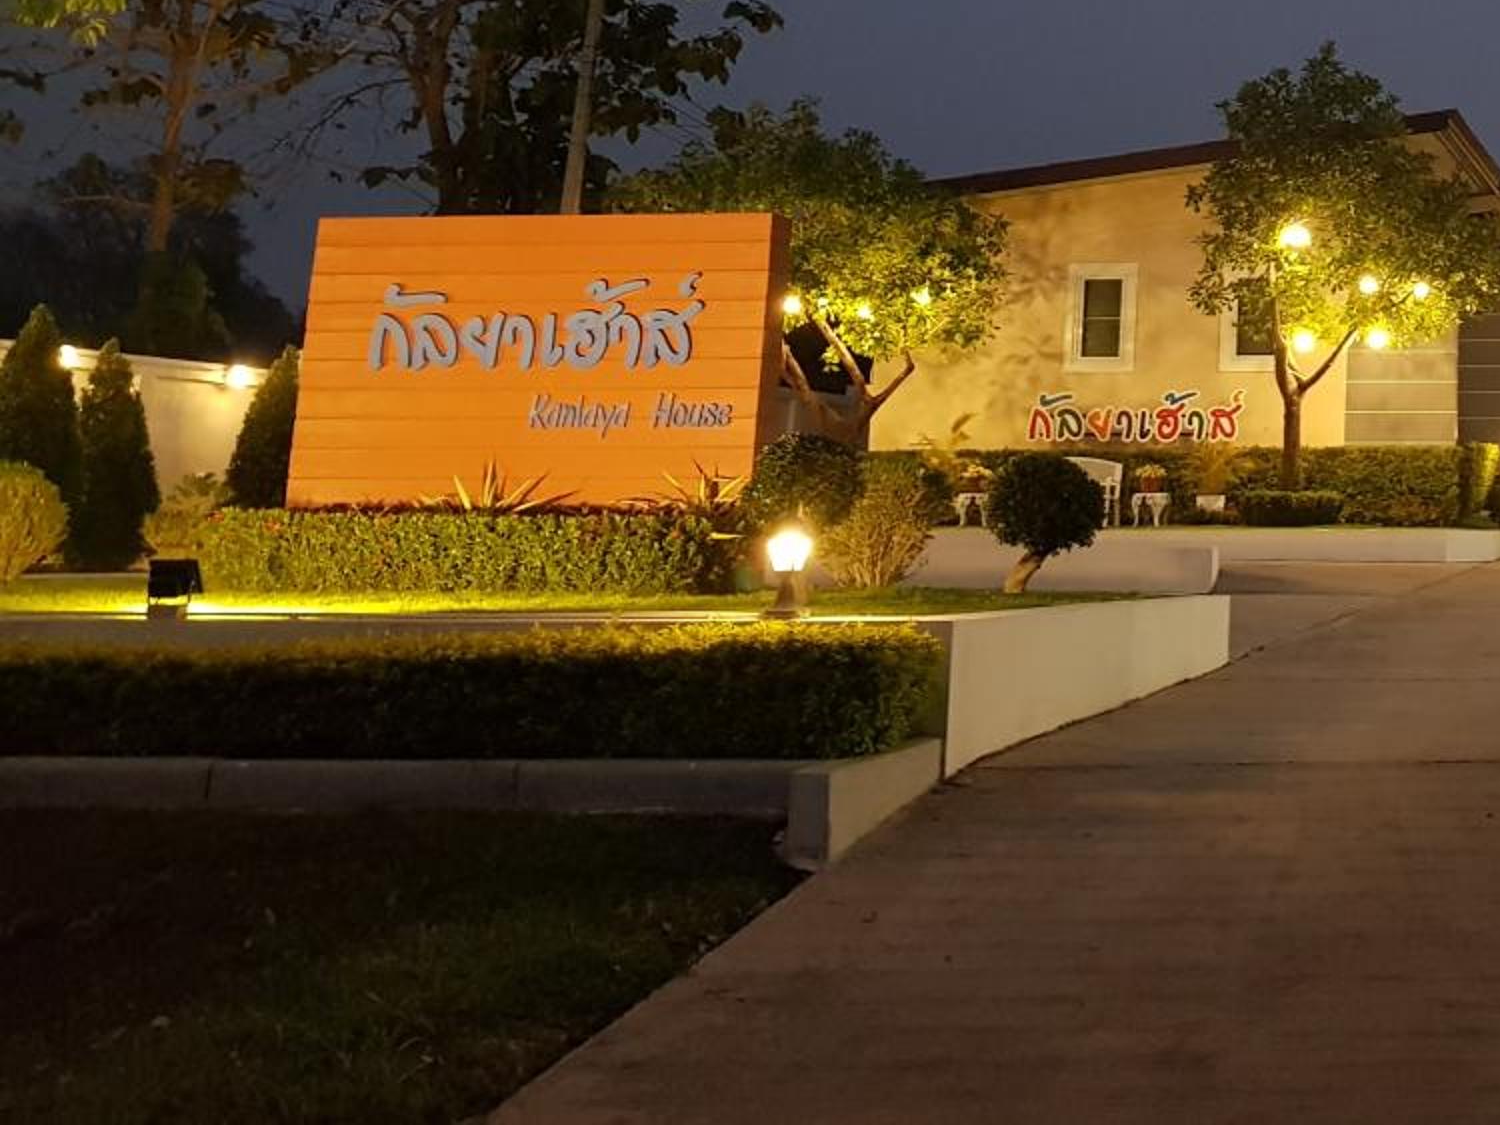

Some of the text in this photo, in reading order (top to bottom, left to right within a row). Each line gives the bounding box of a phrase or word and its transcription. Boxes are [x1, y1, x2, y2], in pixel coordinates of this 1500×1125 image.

[368, 272, 705, 371] กัลยาเฮ้าส์
[529, 391, 734, 439] Kanlaya House
[1027, 390, 1245, 442] กัลยาเฮ้าส์
